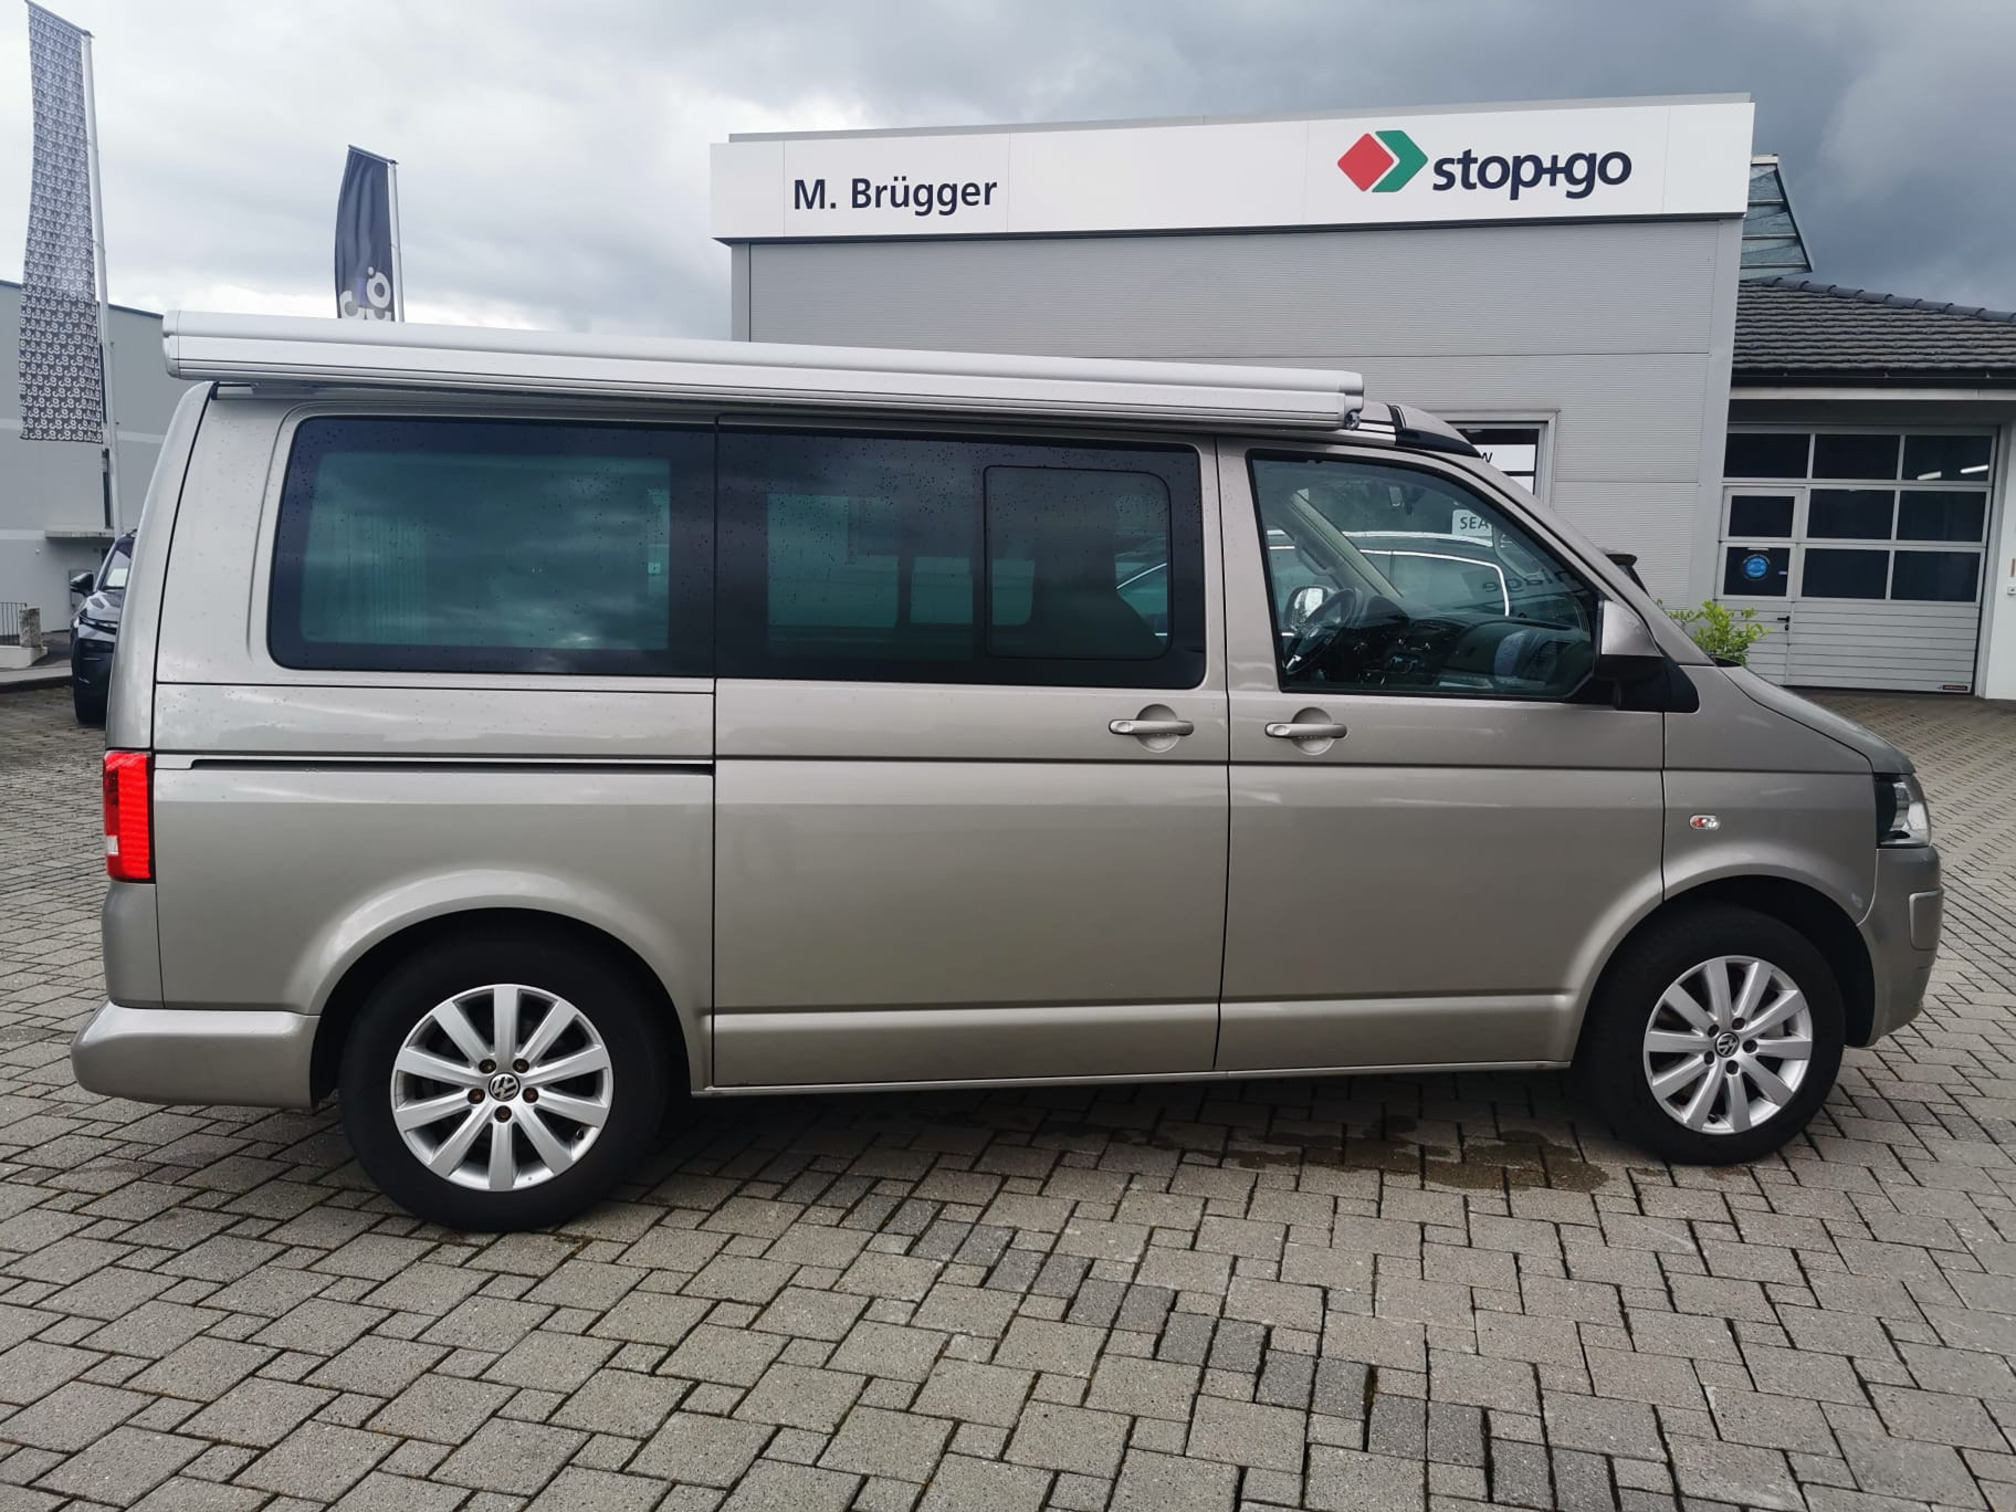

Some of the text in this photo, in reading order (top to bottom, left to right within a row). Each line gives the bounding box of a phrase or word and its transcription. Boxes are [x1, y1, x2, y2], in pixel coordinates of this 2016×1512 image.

[794, 175, 998, 217] M. Brügger
[1432, 148, 1633, 201] stop+go
